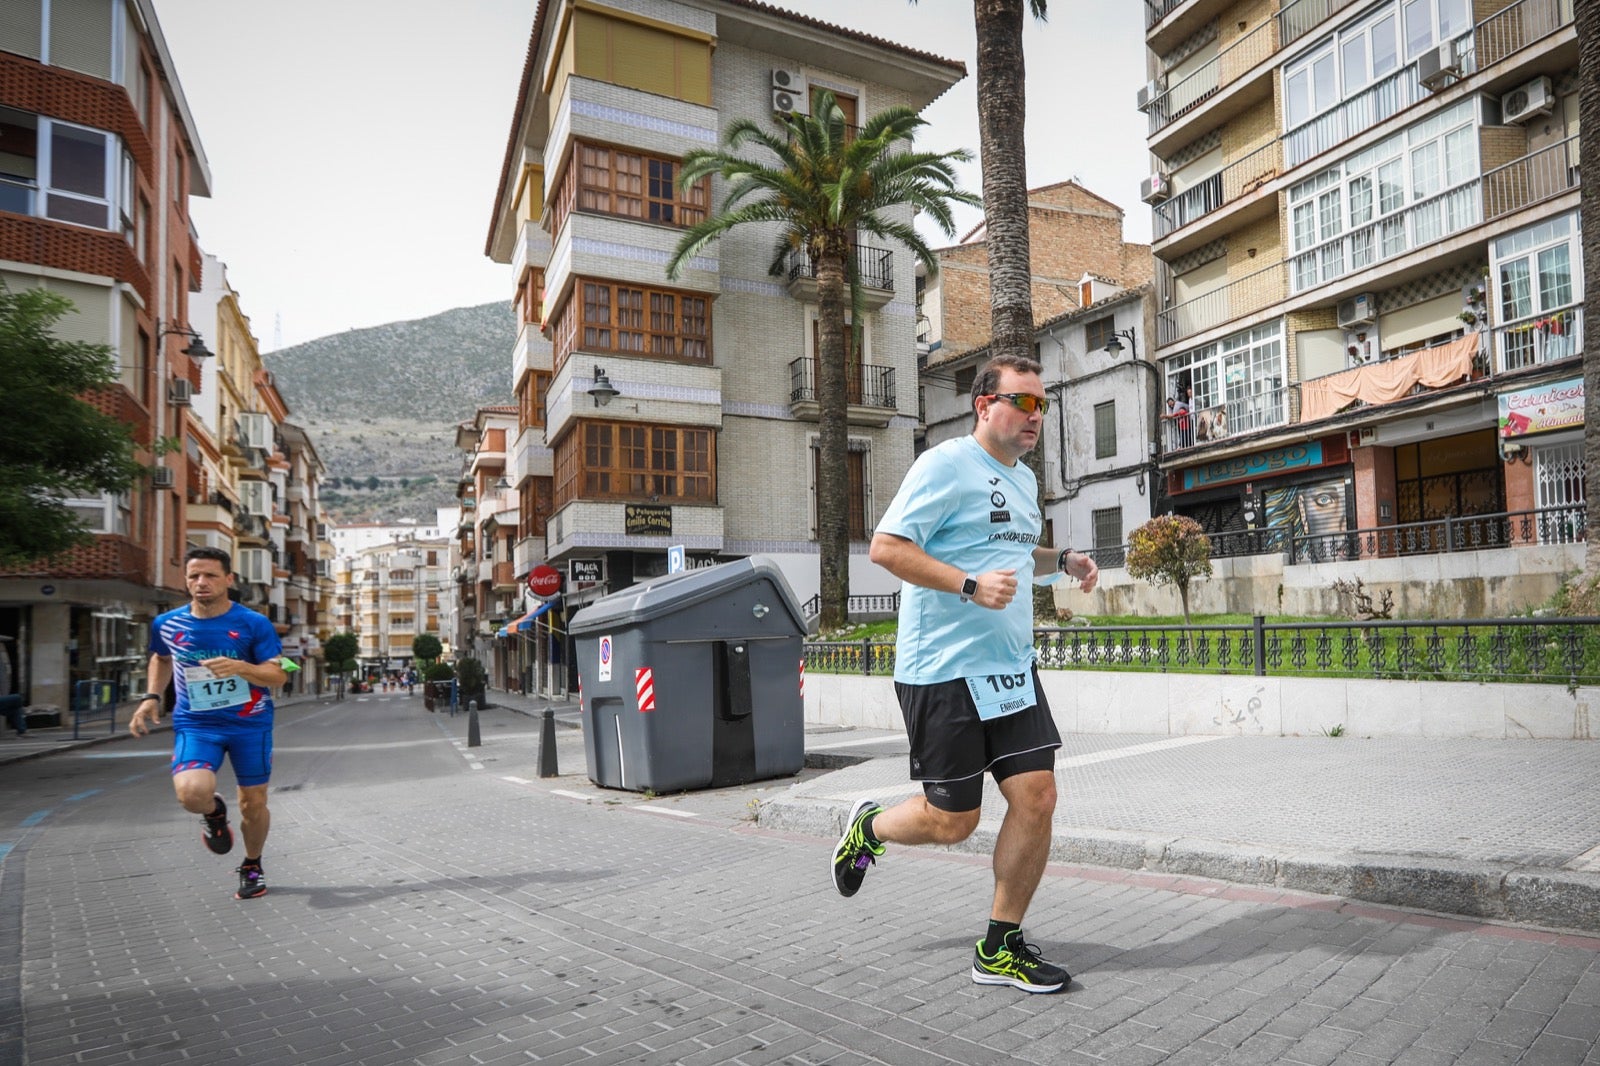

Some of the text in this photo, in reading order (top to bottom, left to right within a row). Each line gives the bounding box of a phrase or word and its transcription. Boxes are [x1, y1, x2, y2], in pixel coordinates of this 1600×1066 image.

[671, 550, 681, 574] P
[203, 679, 237, 695] 173
[1000, 698, 1027, 712] ENRIQUE
